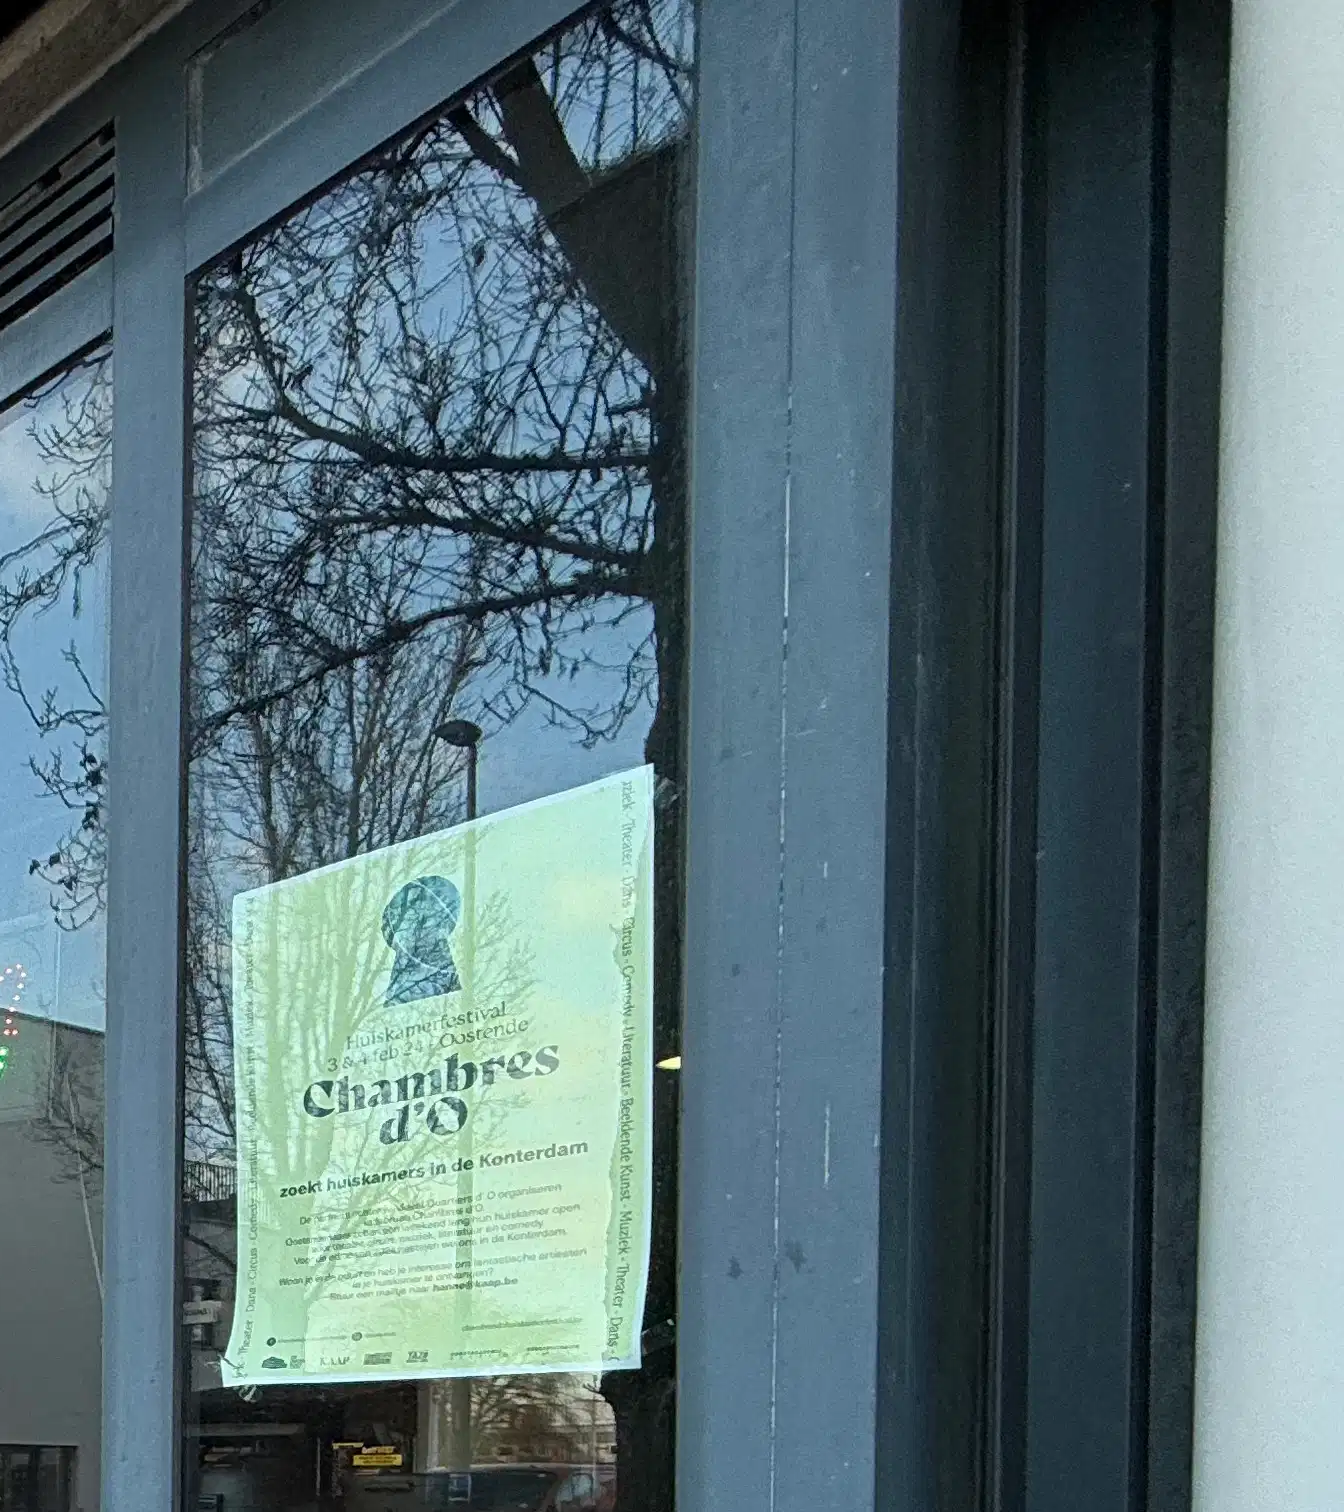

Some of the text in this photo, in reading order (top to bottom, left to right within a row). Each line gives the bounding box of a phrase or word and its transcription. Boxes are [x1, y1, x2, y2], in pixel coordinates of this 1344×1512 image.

[327, 1057, 338, 1073] 3
[372, 1047, 400, 1063] feb
[439, 1018, 529, 1049] Oostende
[346, 1001, 506, 1050] Huiskamerfestival
[303, 1045, 560, 1118] Chambres
[379, 1096, 468, 1145] d'O
[619, 1098, 635, 1163] Beeldende
[279, 1140, 589, 1198] zoekt huiskamers in de Konterdam
[619, 1164, 633, 1201] Kunst
[617, 1211, 632, 1254] Muziek
[612, 1263, 630, 1306] Theater
[607, 1317, 623, 1347] Dans
